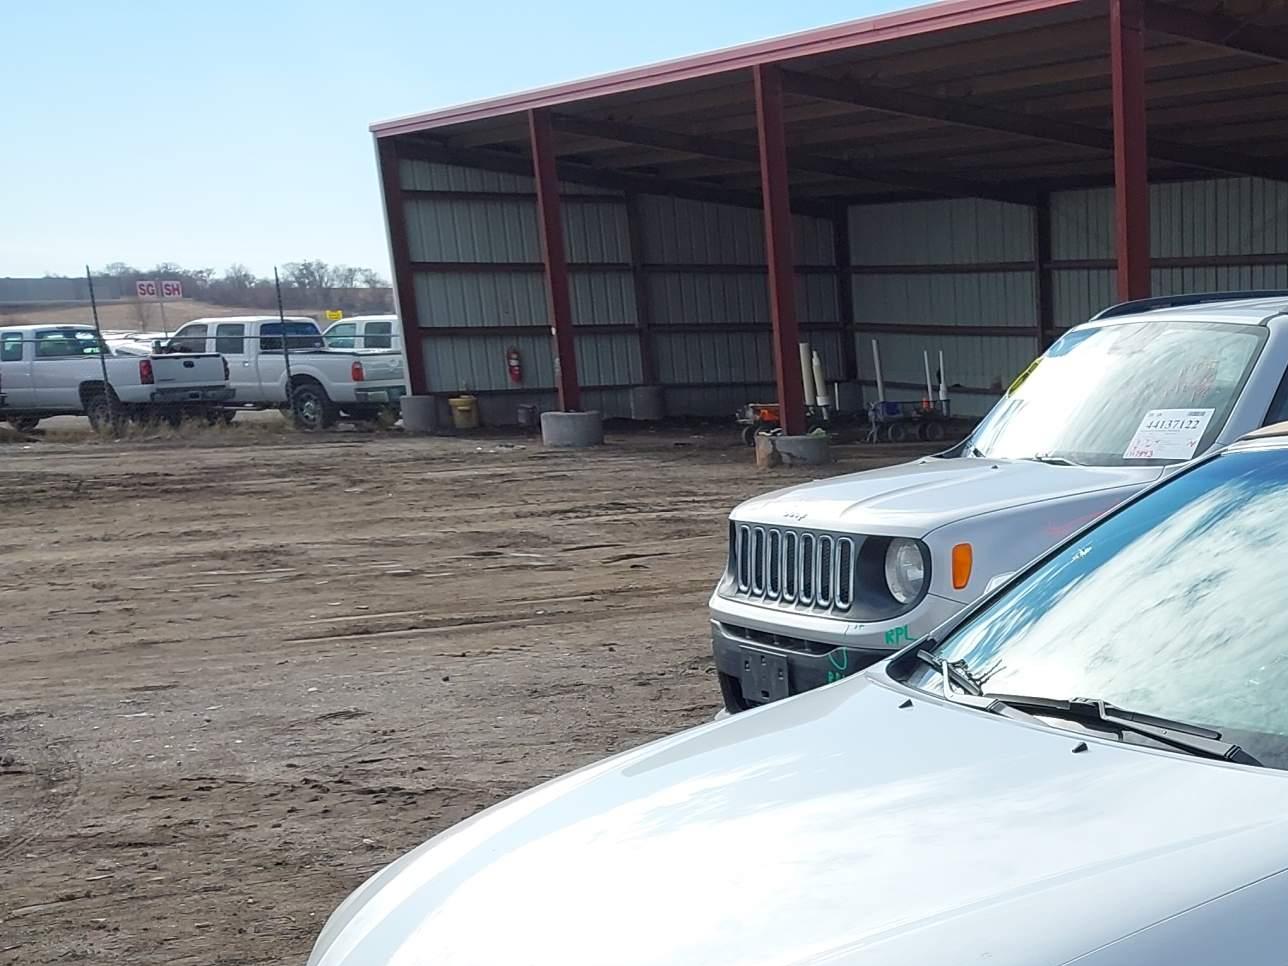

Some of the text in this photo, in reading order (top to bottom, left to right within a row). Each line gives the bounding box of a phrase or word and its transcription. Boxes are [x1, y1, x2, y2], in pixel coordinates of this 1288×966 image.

[138, 283, 155, 296] SG
[164, 283, 181, 296] SH
[1145, 419, 1200, 430] 44137122
